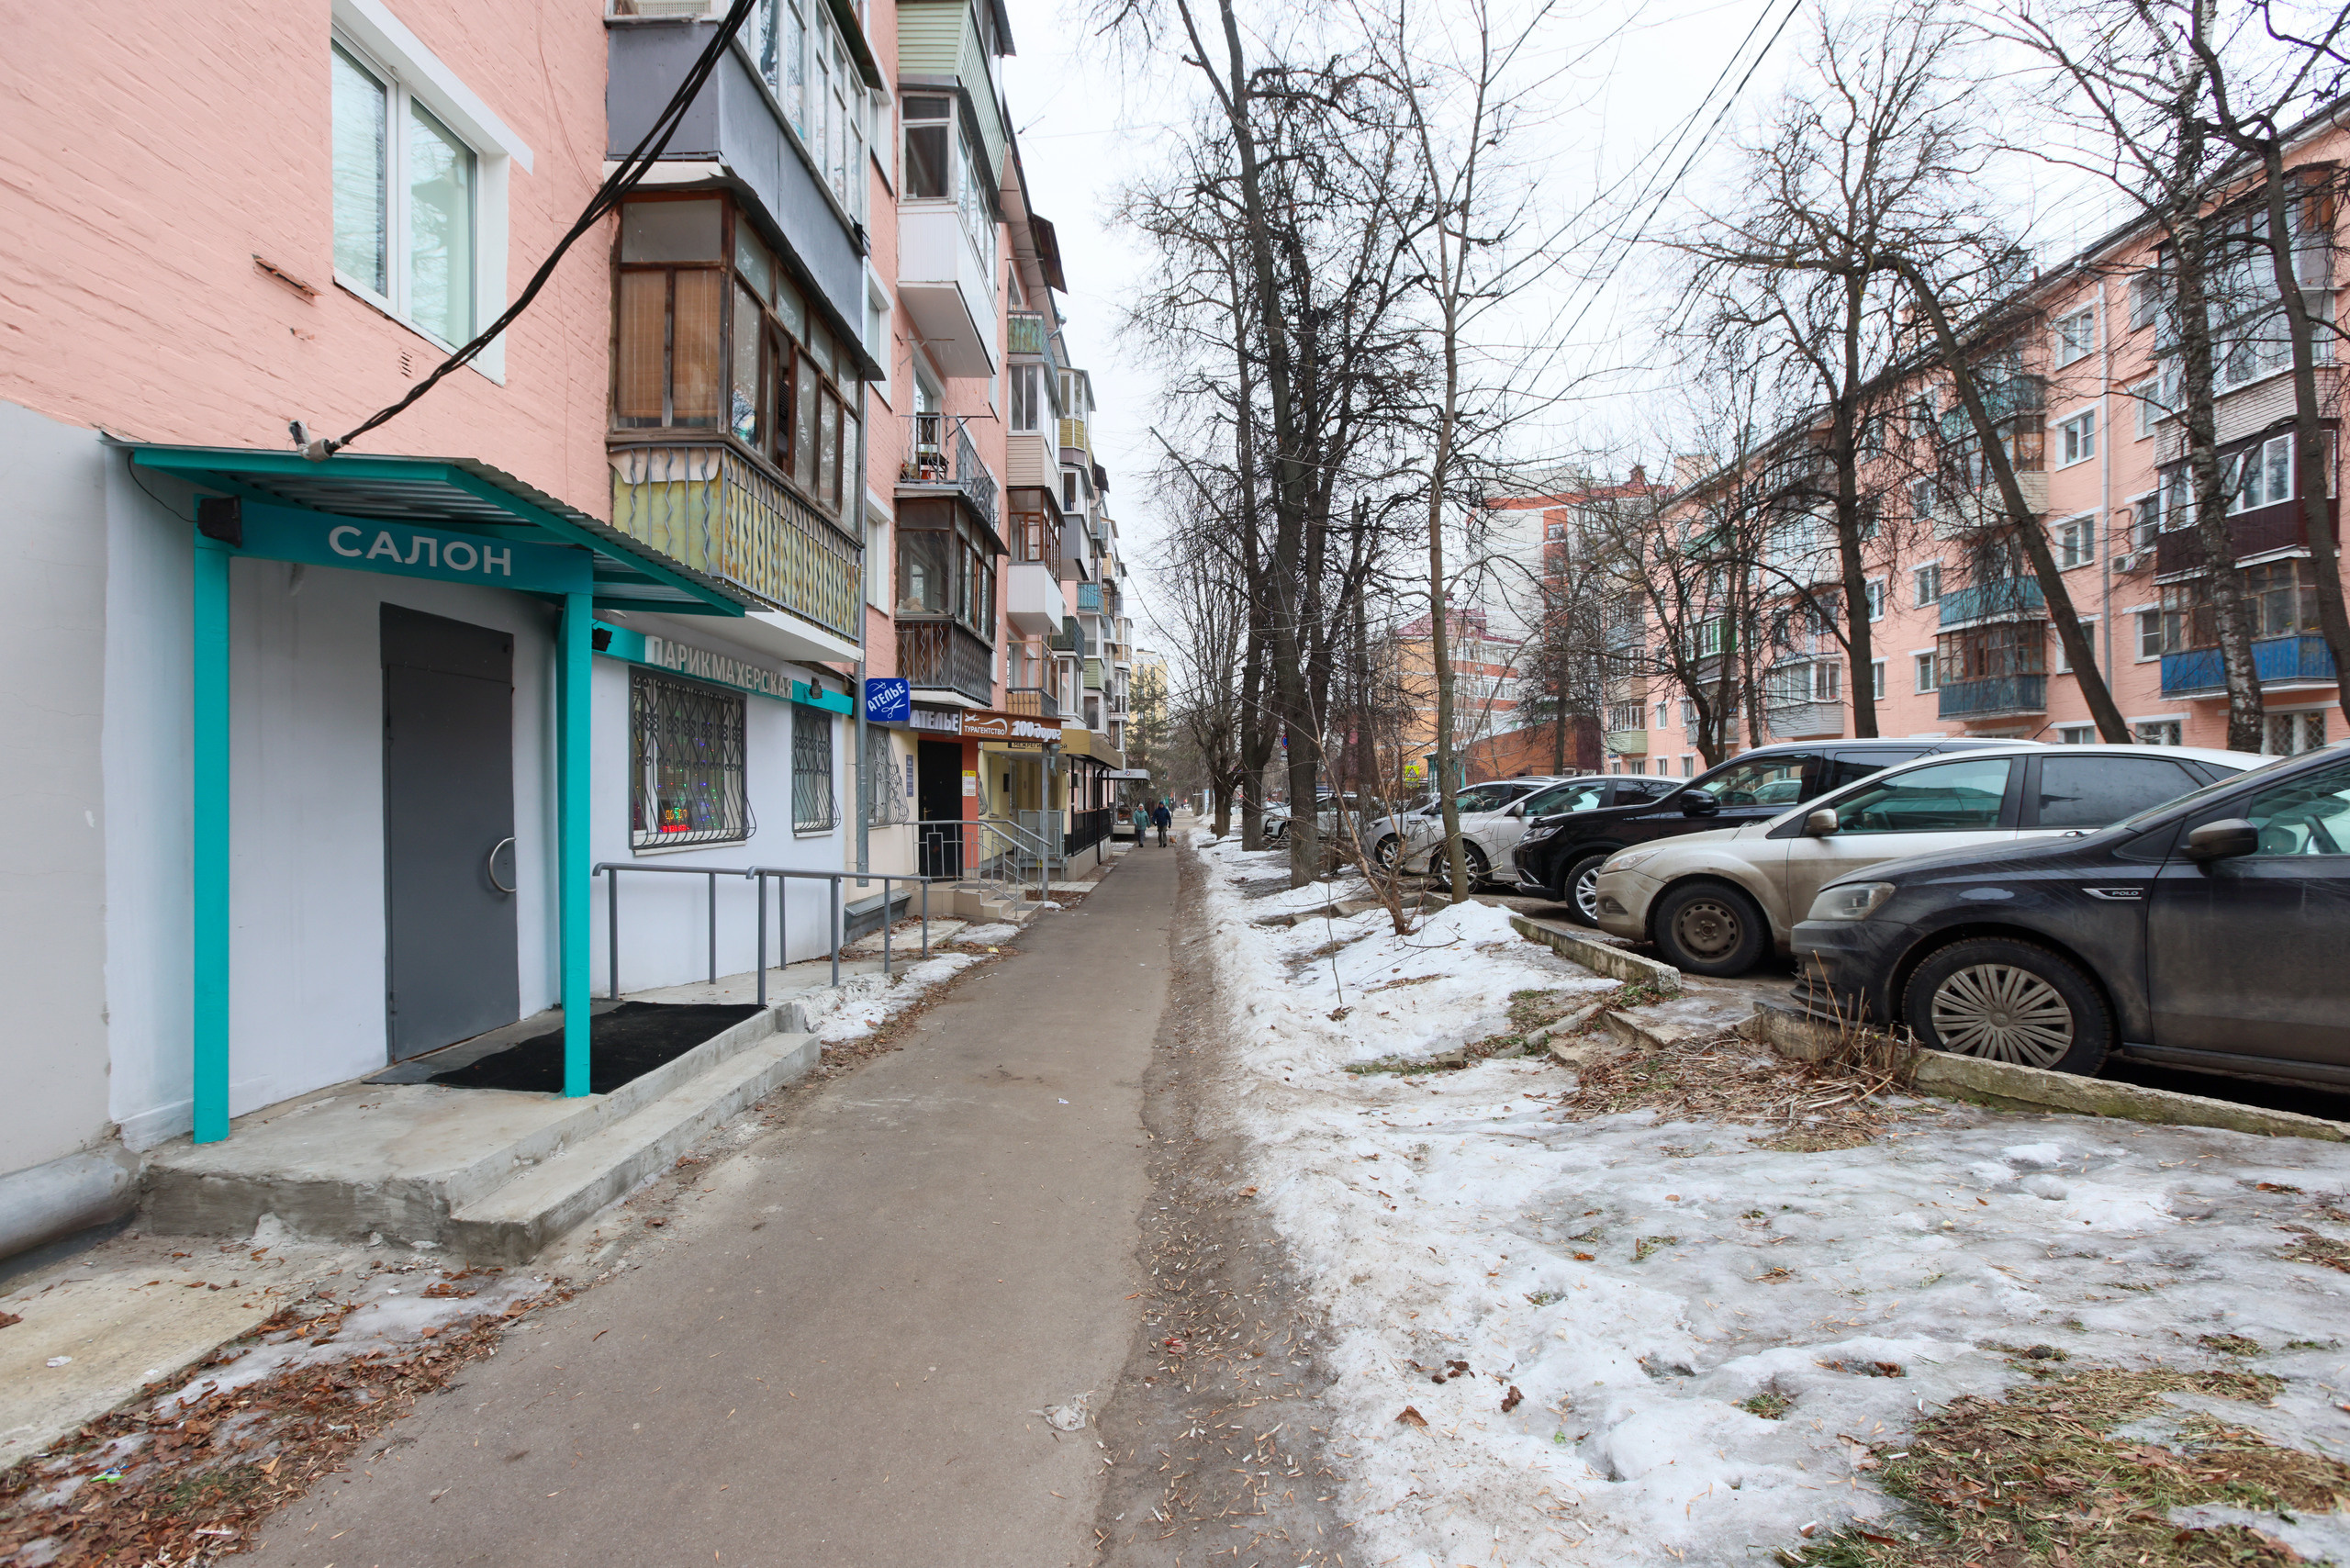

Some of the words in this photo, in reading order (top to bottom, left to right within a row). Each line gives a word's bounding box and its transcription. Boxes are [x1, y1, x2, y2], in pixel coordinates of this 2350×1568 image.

[329, 525, 511, 577] САЛОН
[645, 635, 793, 700] ПАРИКМАХЕРСКАЯ
[867, 682, 906, 712] АТЕЛЬЕ
[910, 710, 958, 731] АТЕЛЬЕ
[964, 725, 1005, 735] ТУРАГЕНТСТВО
